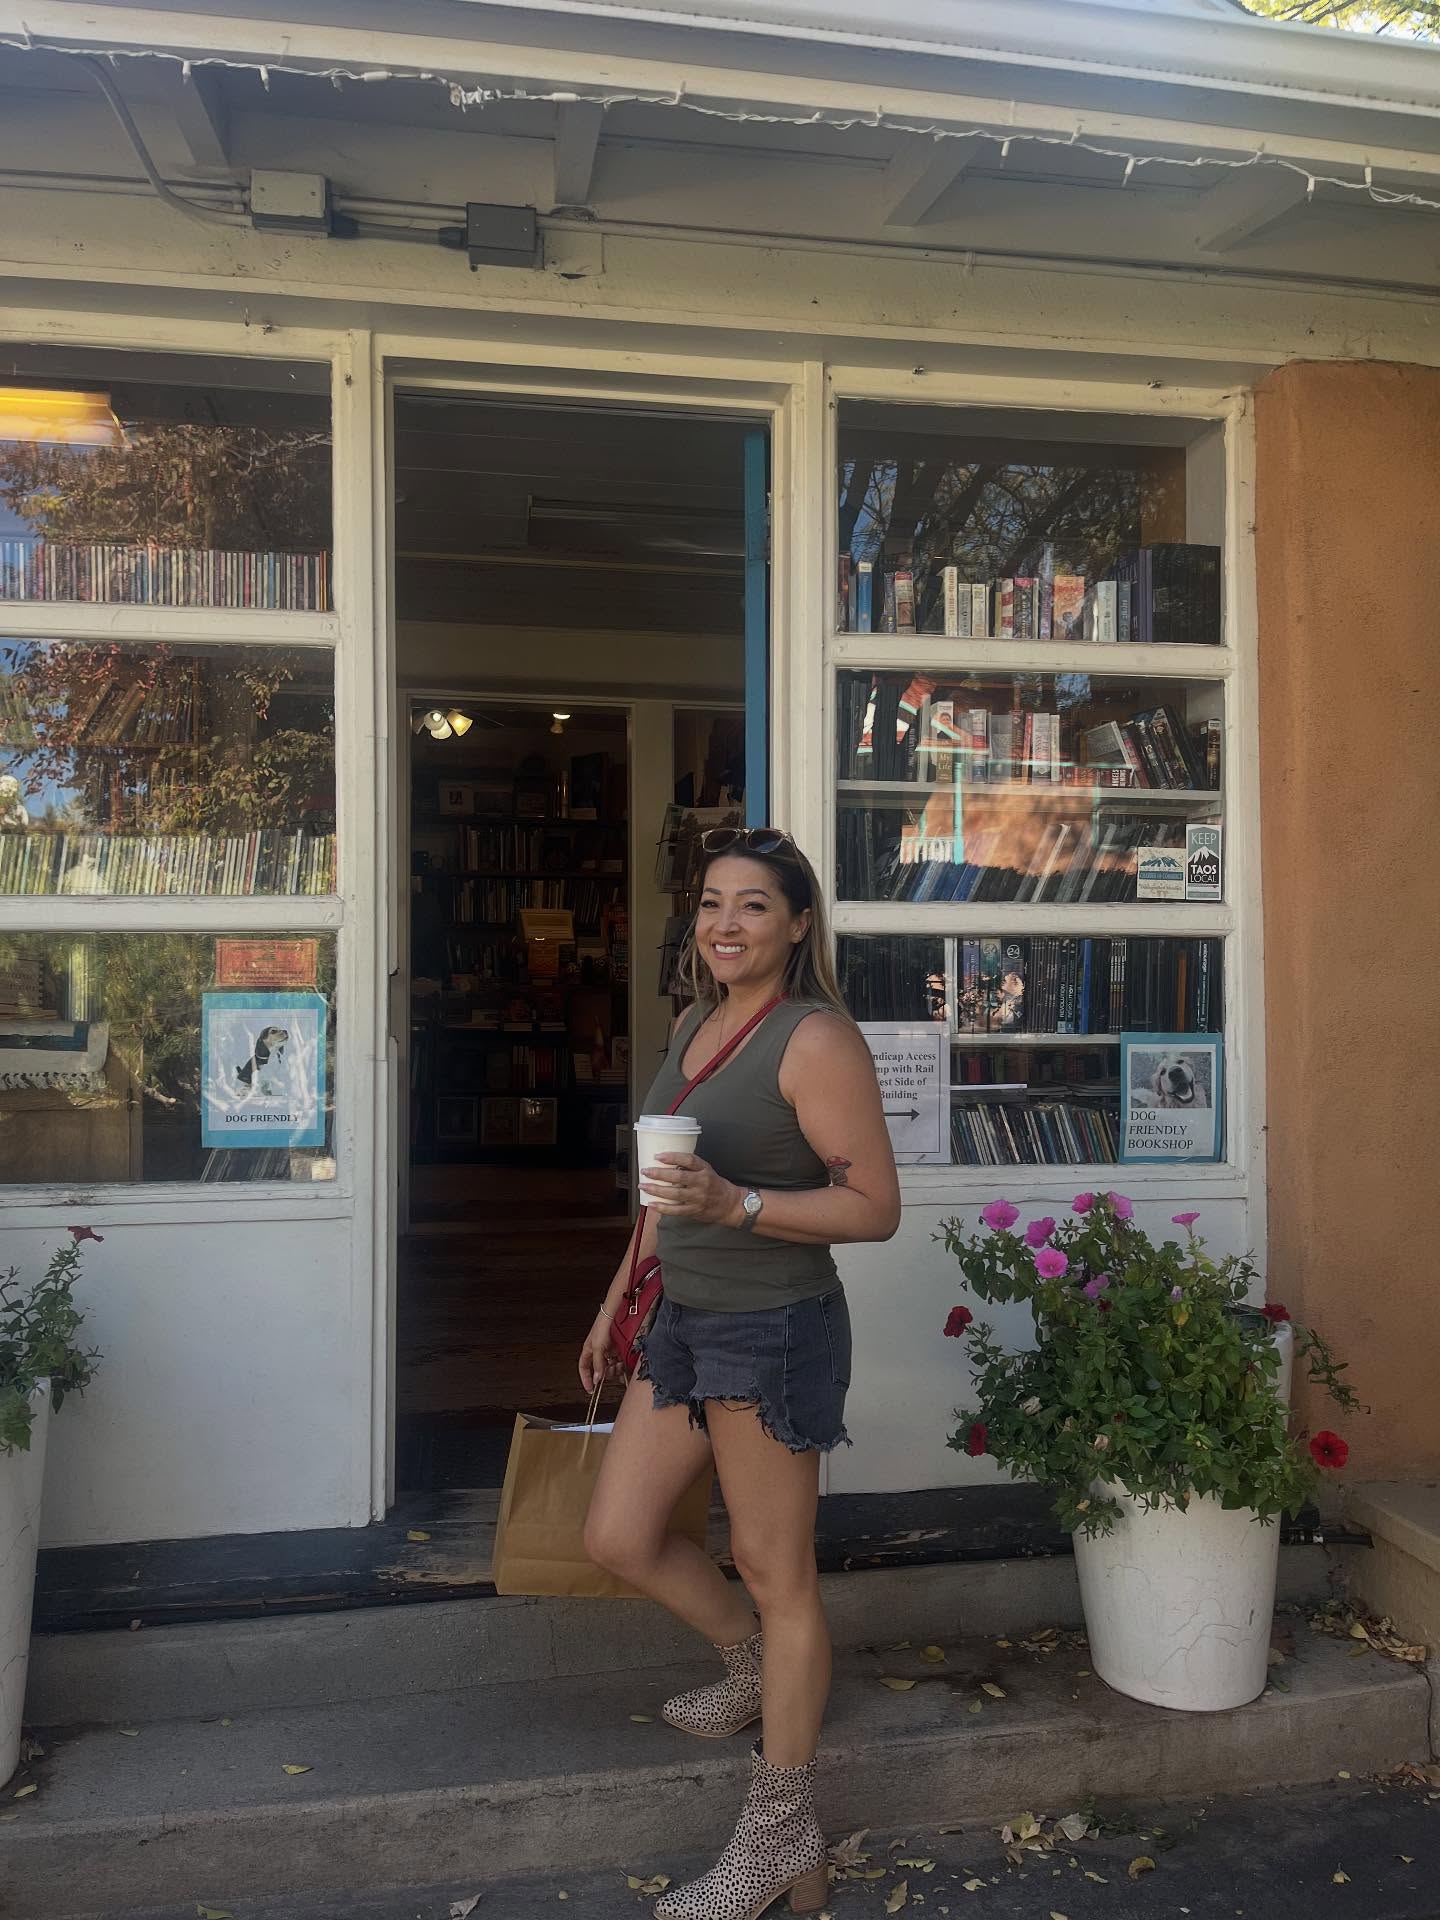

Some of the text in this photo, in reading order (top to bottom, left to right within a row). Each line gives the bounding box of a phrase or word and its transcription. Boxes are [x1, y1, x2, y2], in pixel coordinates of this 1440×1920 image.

[1191, 832, 1217, 845] KEEP
[1190, 864, 1217, 875] TAOS
[1190, 874, 1217, 883] LOCAL
[1008, 946, 1020, 956] 24
[873, 1052, 937, 1062] ndicap Access
[875, 1065, 934, 1075] mp with Rail
[879, 1077, 927, 1087] est Side of
[225, 1113, 299, 1123] DOG FRIENDLY
[1130, 1111, 1156, 1121] DOG
[1129, 1125, 1188, 1136] FRIENDLY
[1128, 1139, 1194, 1150] BOOKSHOP
